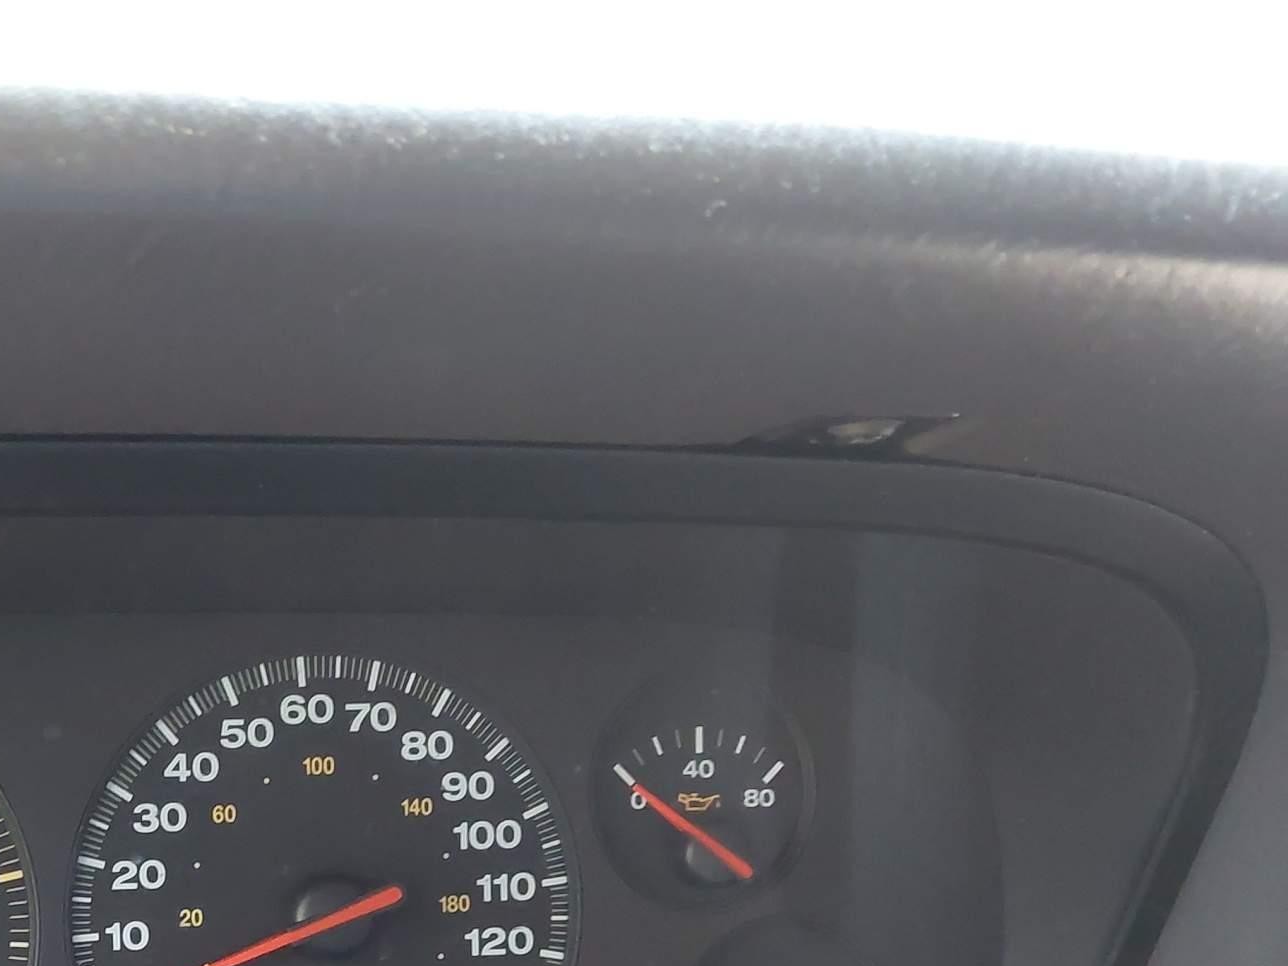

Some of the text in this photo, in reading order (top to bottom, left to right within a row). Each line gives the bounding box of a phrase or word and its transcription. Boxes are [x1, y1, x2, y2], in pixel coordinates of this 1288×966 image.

[280, 694, 333, 724] 60
[345, 702, 396, 731] 70
[220, 718, 273, 748] 50
[401, 731, 453, 760] 80
[164, 752, 219, 782] 40
[303, 757, 334, 775] 100
[683, 760, 714, 778] 40
[442, 771, 494, 801] 90
[631, 792, 647, 809] 0
[744, 789, 774, 807] 80
[133, 803, 186, 833] 30
[213, 805, 236, 823] 60
[401, 798, 432, 816] 140
[453, 820, 521, 849] 100
[112, 860, 165, 890] 20
[477, 872, 535, 901] 110
[180, 909, 202, 927] 20
[440, 895, 470, 912] 180
[105, 921, 149, 950] 10
[465, 926, 533, 956] 120
